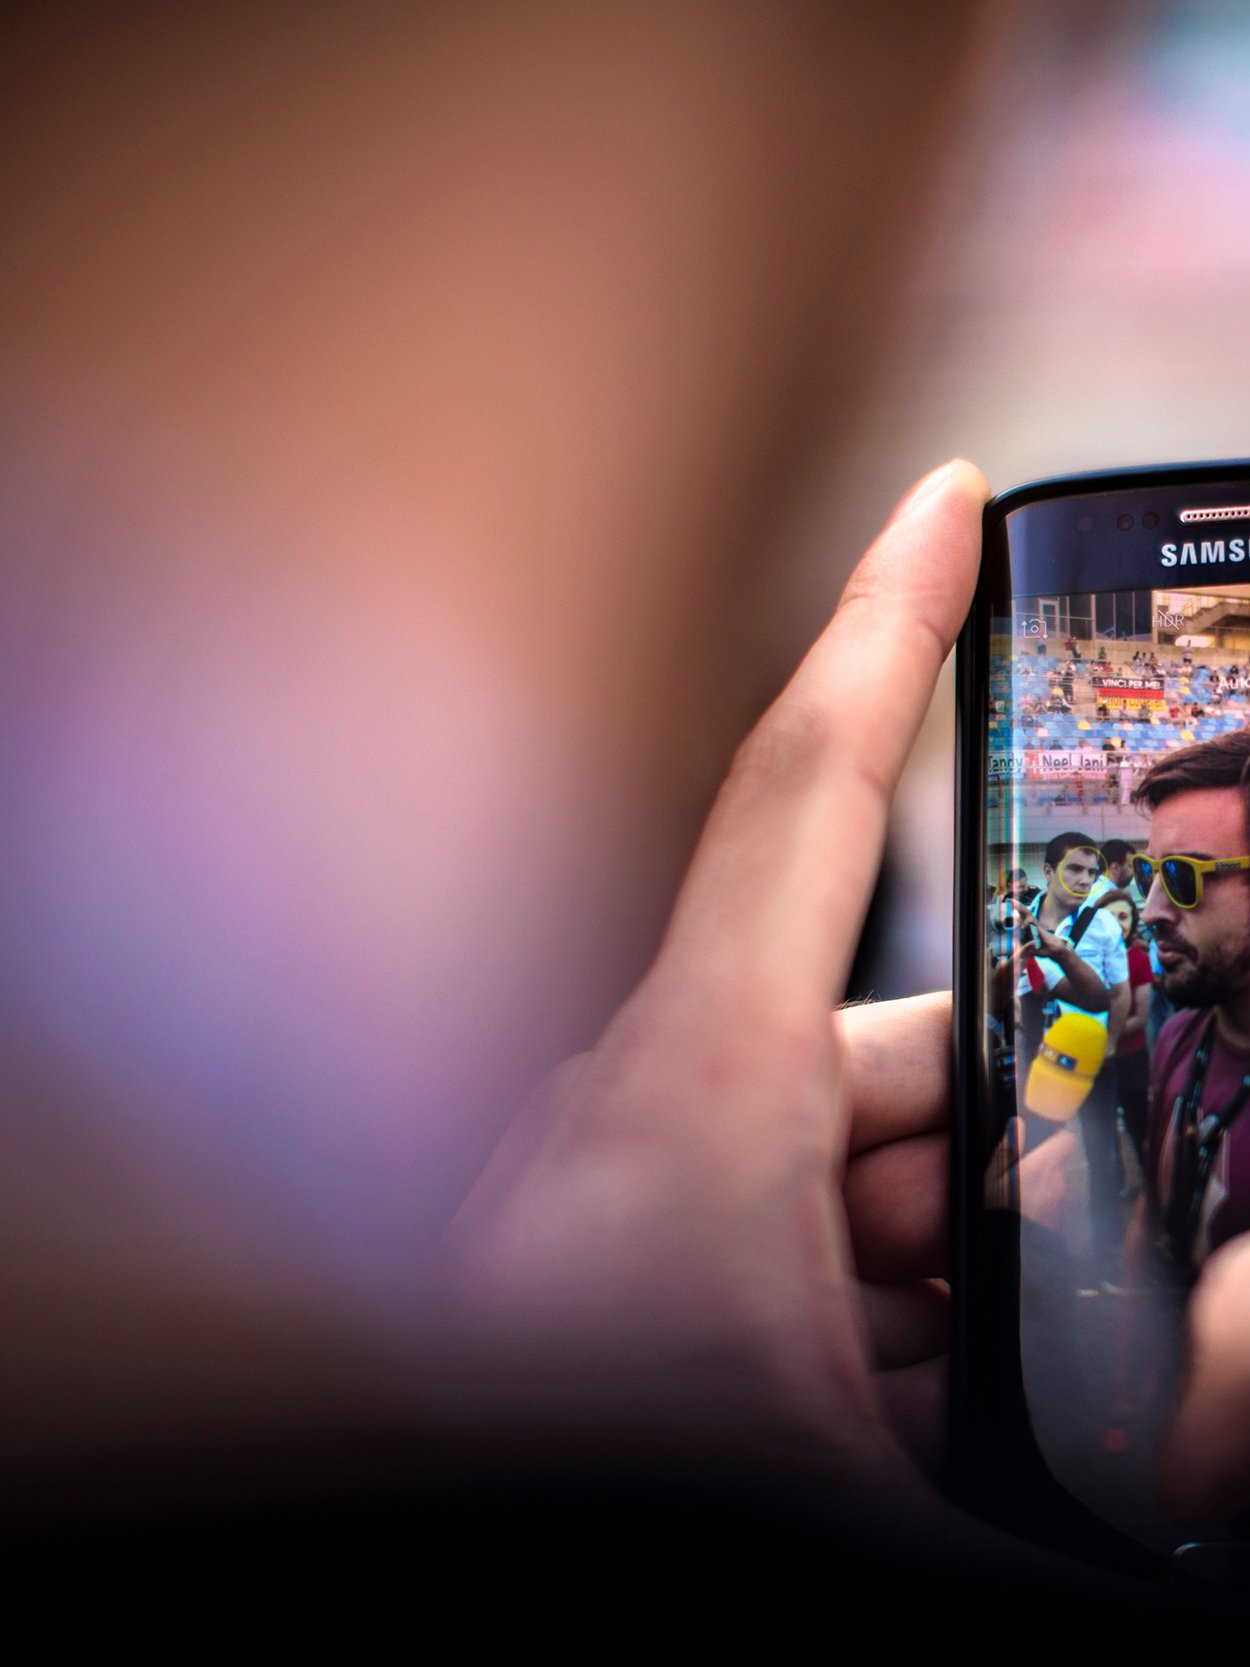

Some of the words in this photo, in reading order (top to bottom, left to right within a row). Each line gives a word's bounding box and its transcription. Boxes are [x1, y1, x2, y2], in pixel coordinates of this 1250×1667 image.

[1152, 612, 1185, 628] HDR
[1102, 679, 1126, 688] VINCI
[1128, 680, 1143, 689] PER
